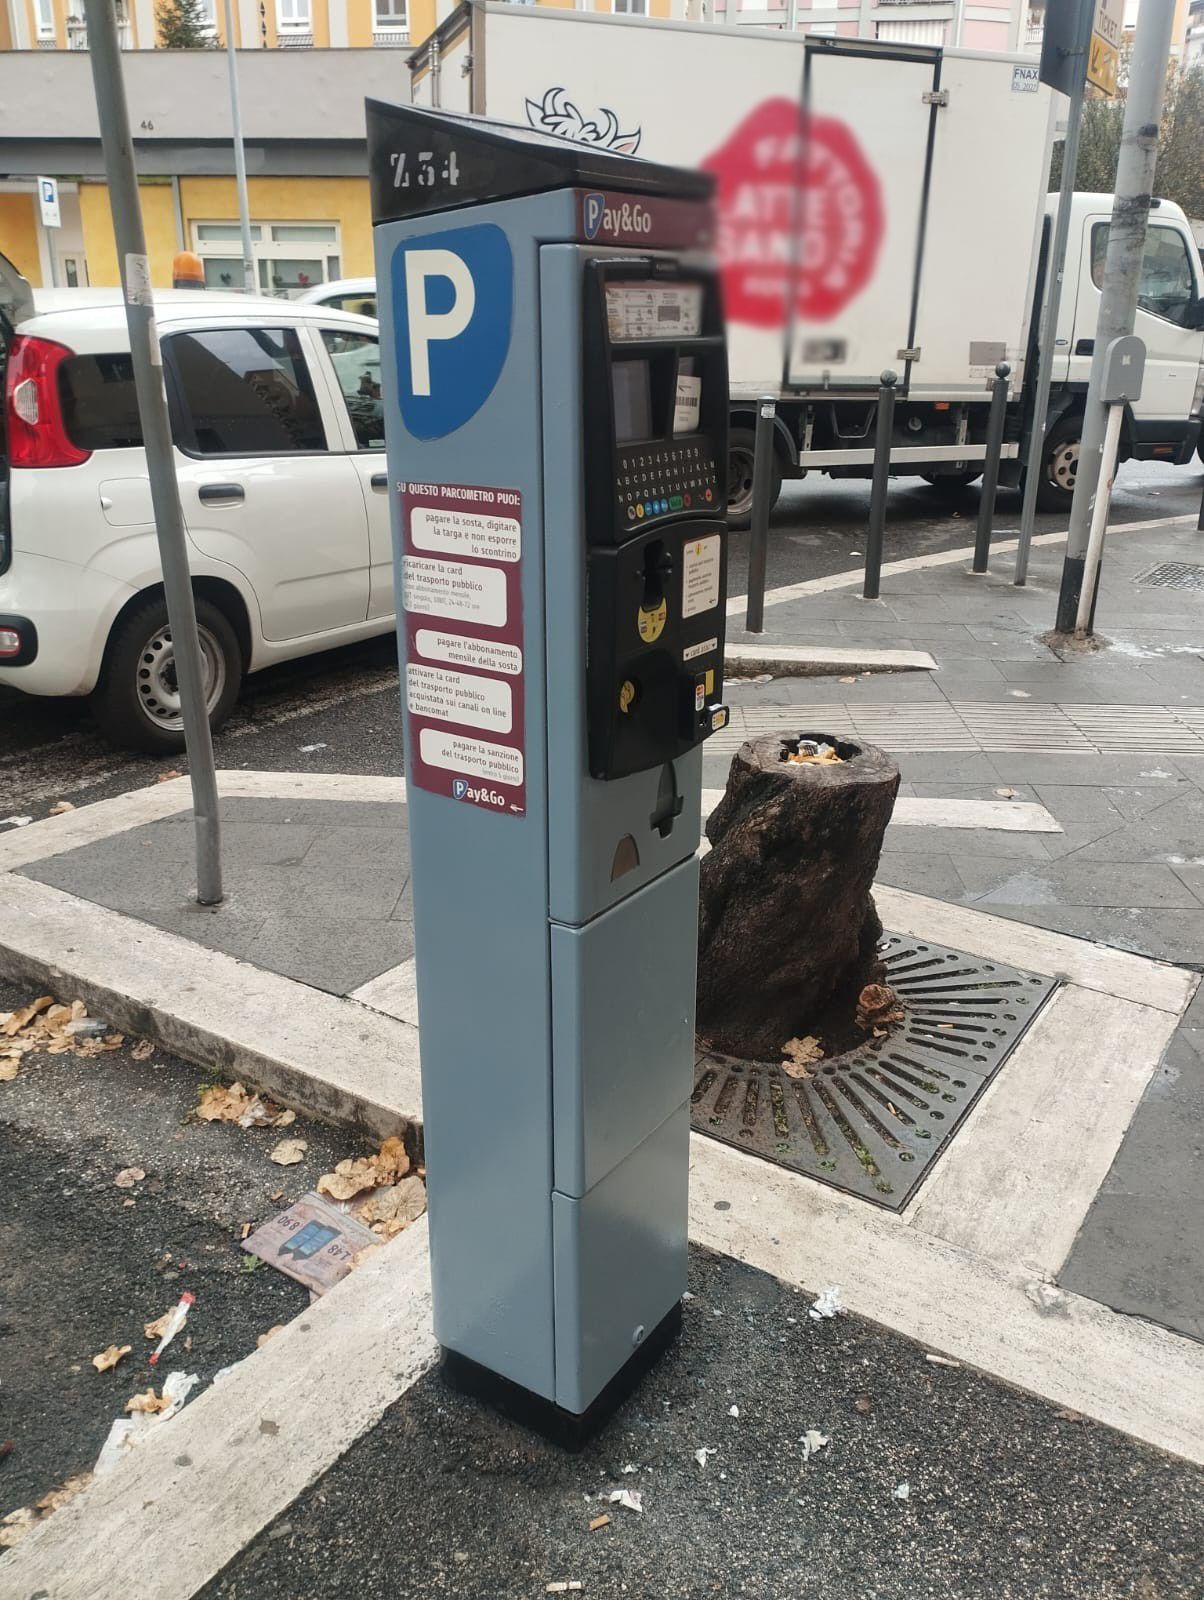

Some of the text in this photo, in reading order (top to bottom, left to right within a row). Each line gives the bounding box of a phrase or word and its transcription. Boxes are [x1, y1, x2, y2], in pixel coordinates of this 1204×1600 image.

[1098, 10, 1118, 40] TICKET
[1014, 68, 1038, 80] FNAX
[141, 120, 154, 130] 46
[588, 198, 652, 237] Pay&Go
[404, 248, 476, 396] P
[397, 482, 520, 506] SU QUESTO PARCOMETRO PUOI:
[426, 514, 516, 532] pagare la sosta, digitare
[434, 527, 440, 535] la
[443, 528, 462, 539] targa
[488, 535, 517, 545] esporre
[472, 545, 517, 559] lo scontrino
[403, 559, 462, 575] ricaricare la card
[404, 572, 482, 591] del trasporto pubblico
[437, 638, 517, 658] pagare l'abbonamento
[448, 652, 518, 671] mensile della sosta
[408, 668, 460, 684] attivare la card
[409, 679, 485, 701] del trasporto pubblico
[409, 692, 444, 704] acquistata
[458, 700, 478, 712] canali
[481, 706, 490, 716] on
[492, 707, 507, 718] line
[416, 702, 448, 716] bancomat
[453, 741, 518, 761] pagare la sanzione
[442, 749, 519, 773] del trasporto pubblico
[456, 780, 506, 806] Pay&Go
